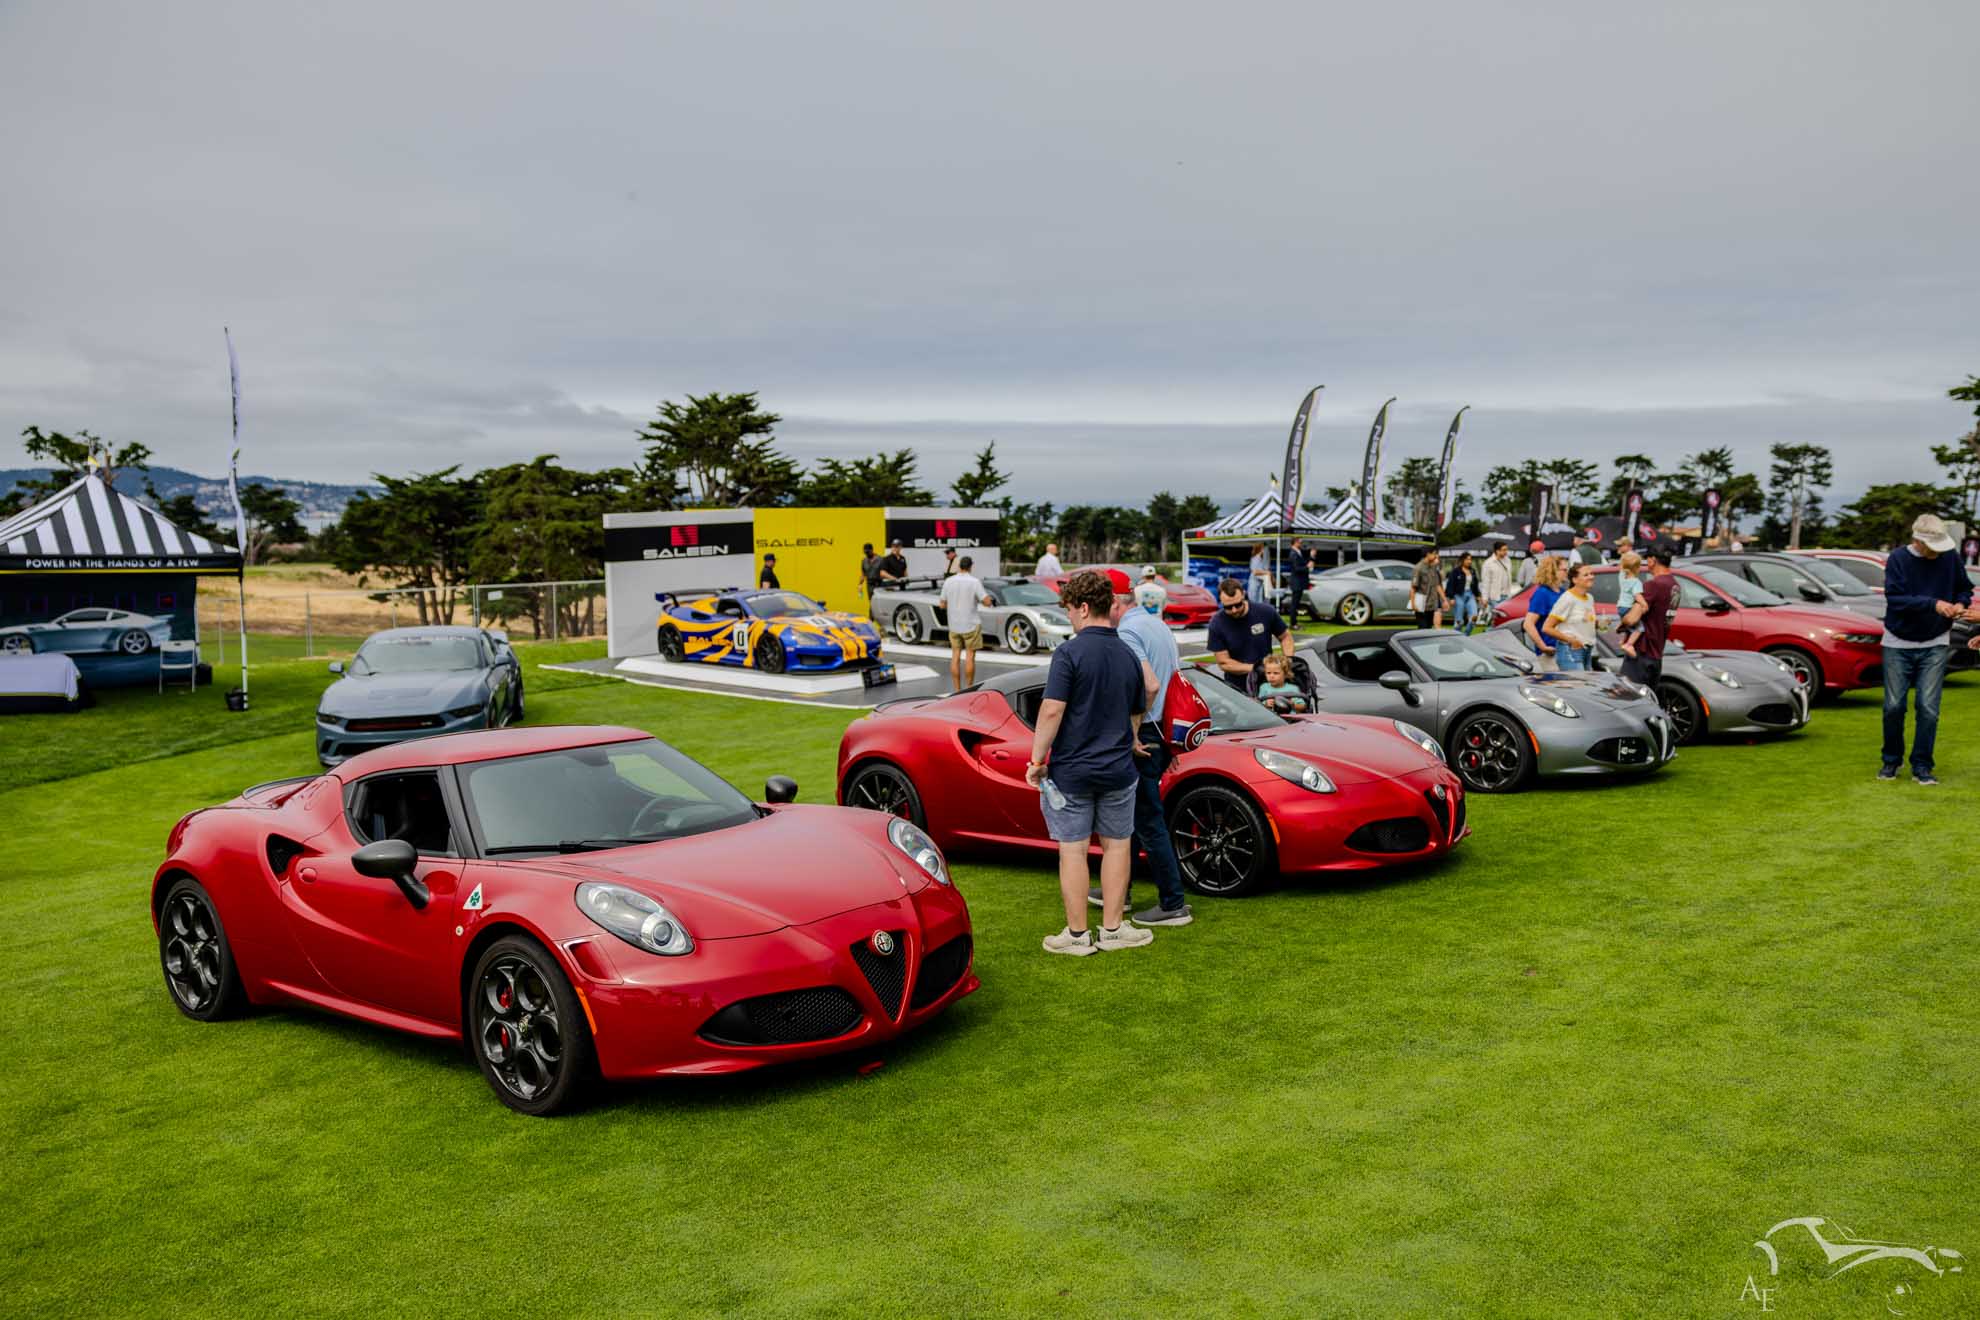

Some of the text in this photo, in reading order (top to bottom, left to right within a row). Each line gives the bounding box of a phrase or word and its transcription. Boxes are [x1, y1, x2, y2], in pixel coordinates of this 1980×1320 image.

[755, 537, 834, 548] SALEEN
[914, 538, 980, 548] SALEEN
[643, 544, 729, 560] SALEEN
[26, 559, 199, 568] POWER IN THE HANDS OF A FEW
[737, 630, 745, 647] 0
